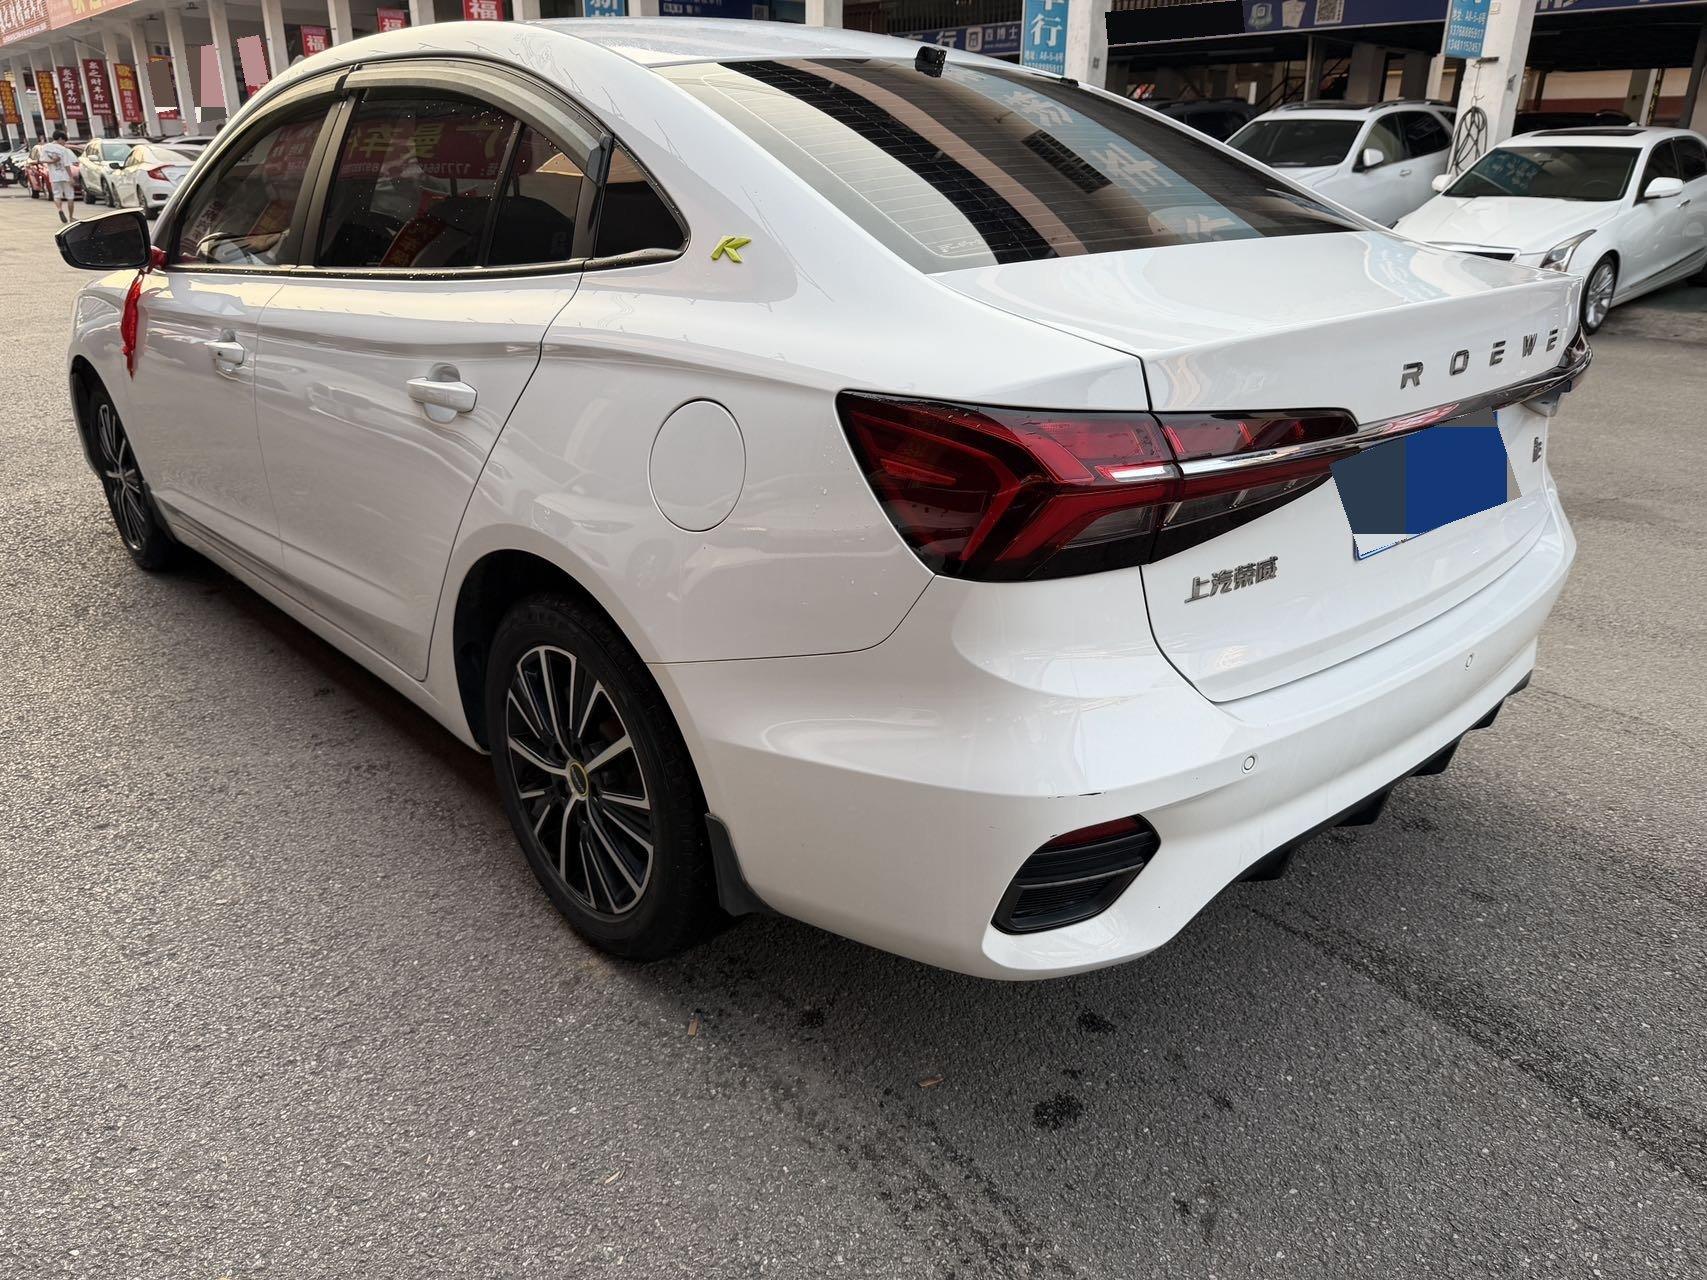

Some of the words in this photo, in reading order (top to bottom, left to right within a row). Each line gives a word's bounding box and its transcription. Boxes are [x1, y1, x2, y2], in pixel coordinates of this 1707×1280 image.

[470, 0, 498, 20] 福
[307, 34, 326, 52] 福
[1400, 328, 1559, 390] ROEWE
[1183, 555, 1279, 604] 上汽荣威
